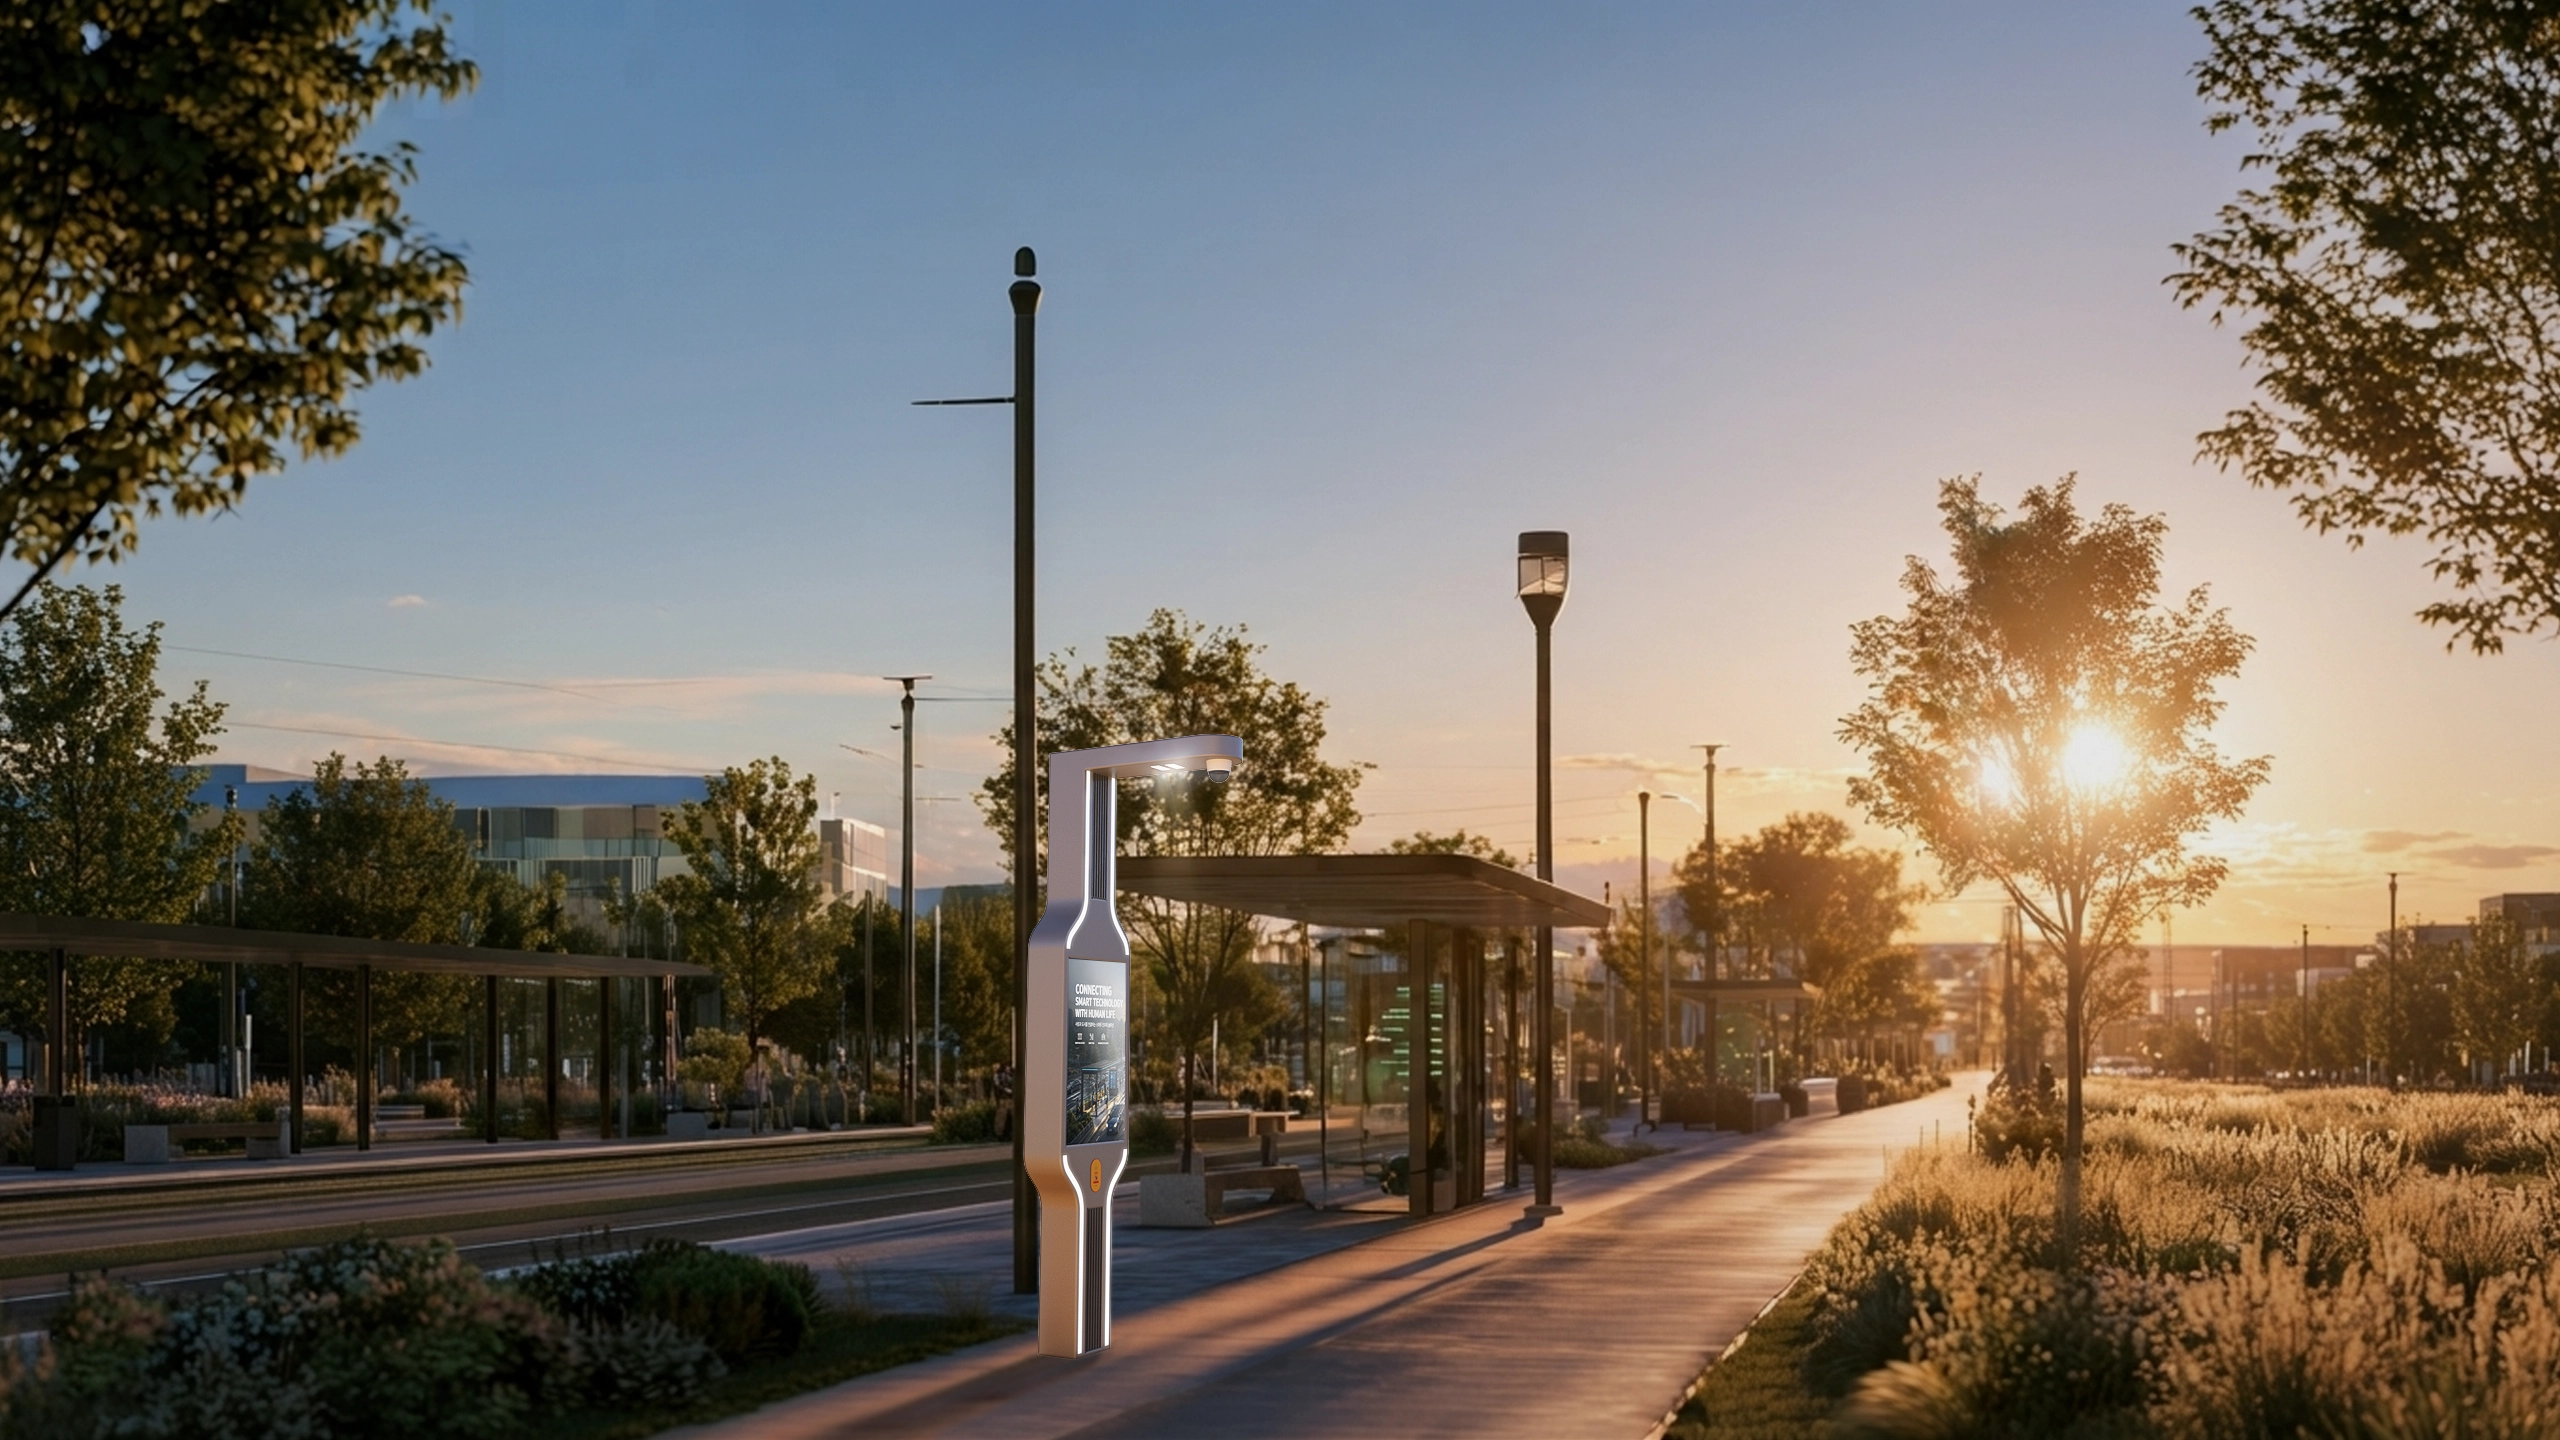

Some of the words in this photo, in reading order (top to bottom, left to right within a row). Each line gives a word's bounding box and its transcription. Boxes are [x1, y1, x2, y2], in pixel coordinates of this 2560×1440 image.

[1075, 983, 1112, 996] CONNECTING
[1075, 996, 1092, 1006] SMART
[1093, 997, 1123, 1008] TECHNOLOGY
[1075, 1008, 1087, 1018] WITH
[1088, 1009, 1105, 1019] HUMAN
[1106, 1010, 1116, 1019] LIFE
